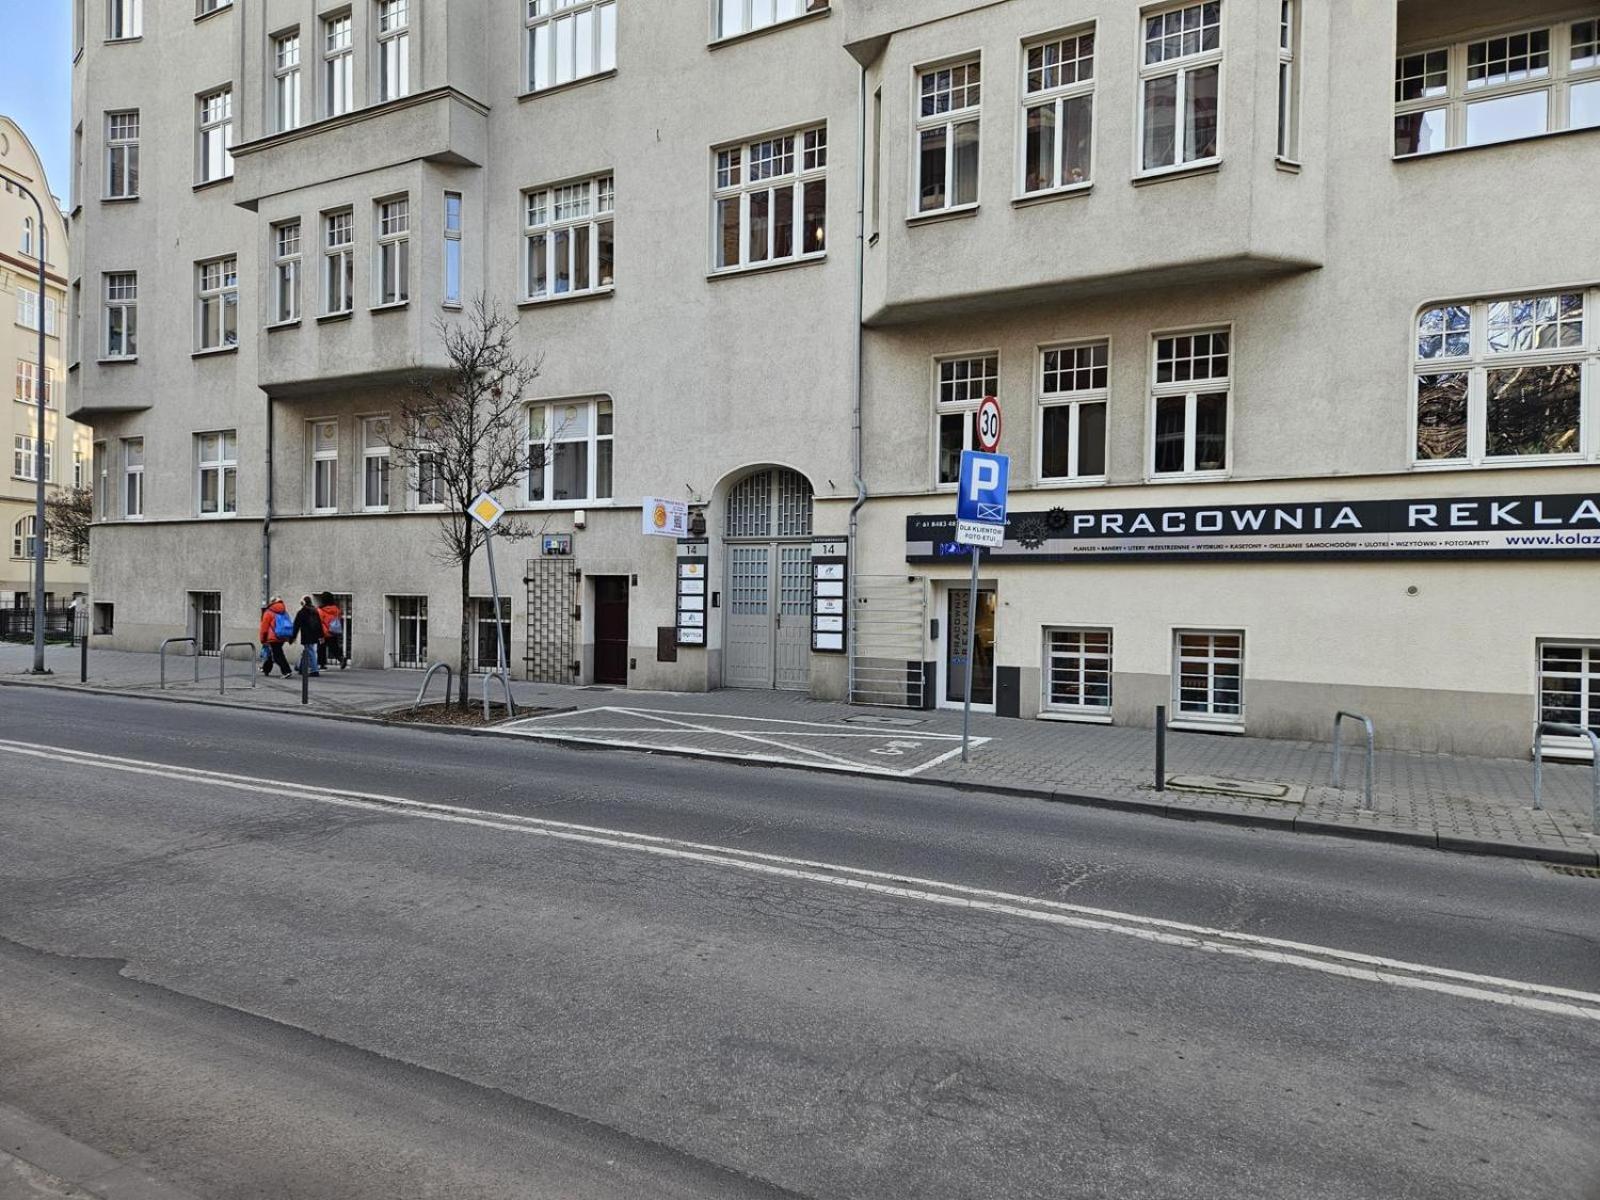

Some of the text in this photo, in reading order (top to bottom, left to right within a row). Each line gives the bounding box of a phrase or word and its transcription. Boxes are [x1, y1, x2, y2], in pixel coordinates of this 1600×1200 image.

[981, 409, 998, 439] 30
[970, 457, 999, 501] P
[1073, 499, 1600, 534] PRACOWNIA REKLA
[686, 545, 697, 555] 14
[822, 544, 835, 554] 14
[1506, 532, 1600, 546] www.kolaz
